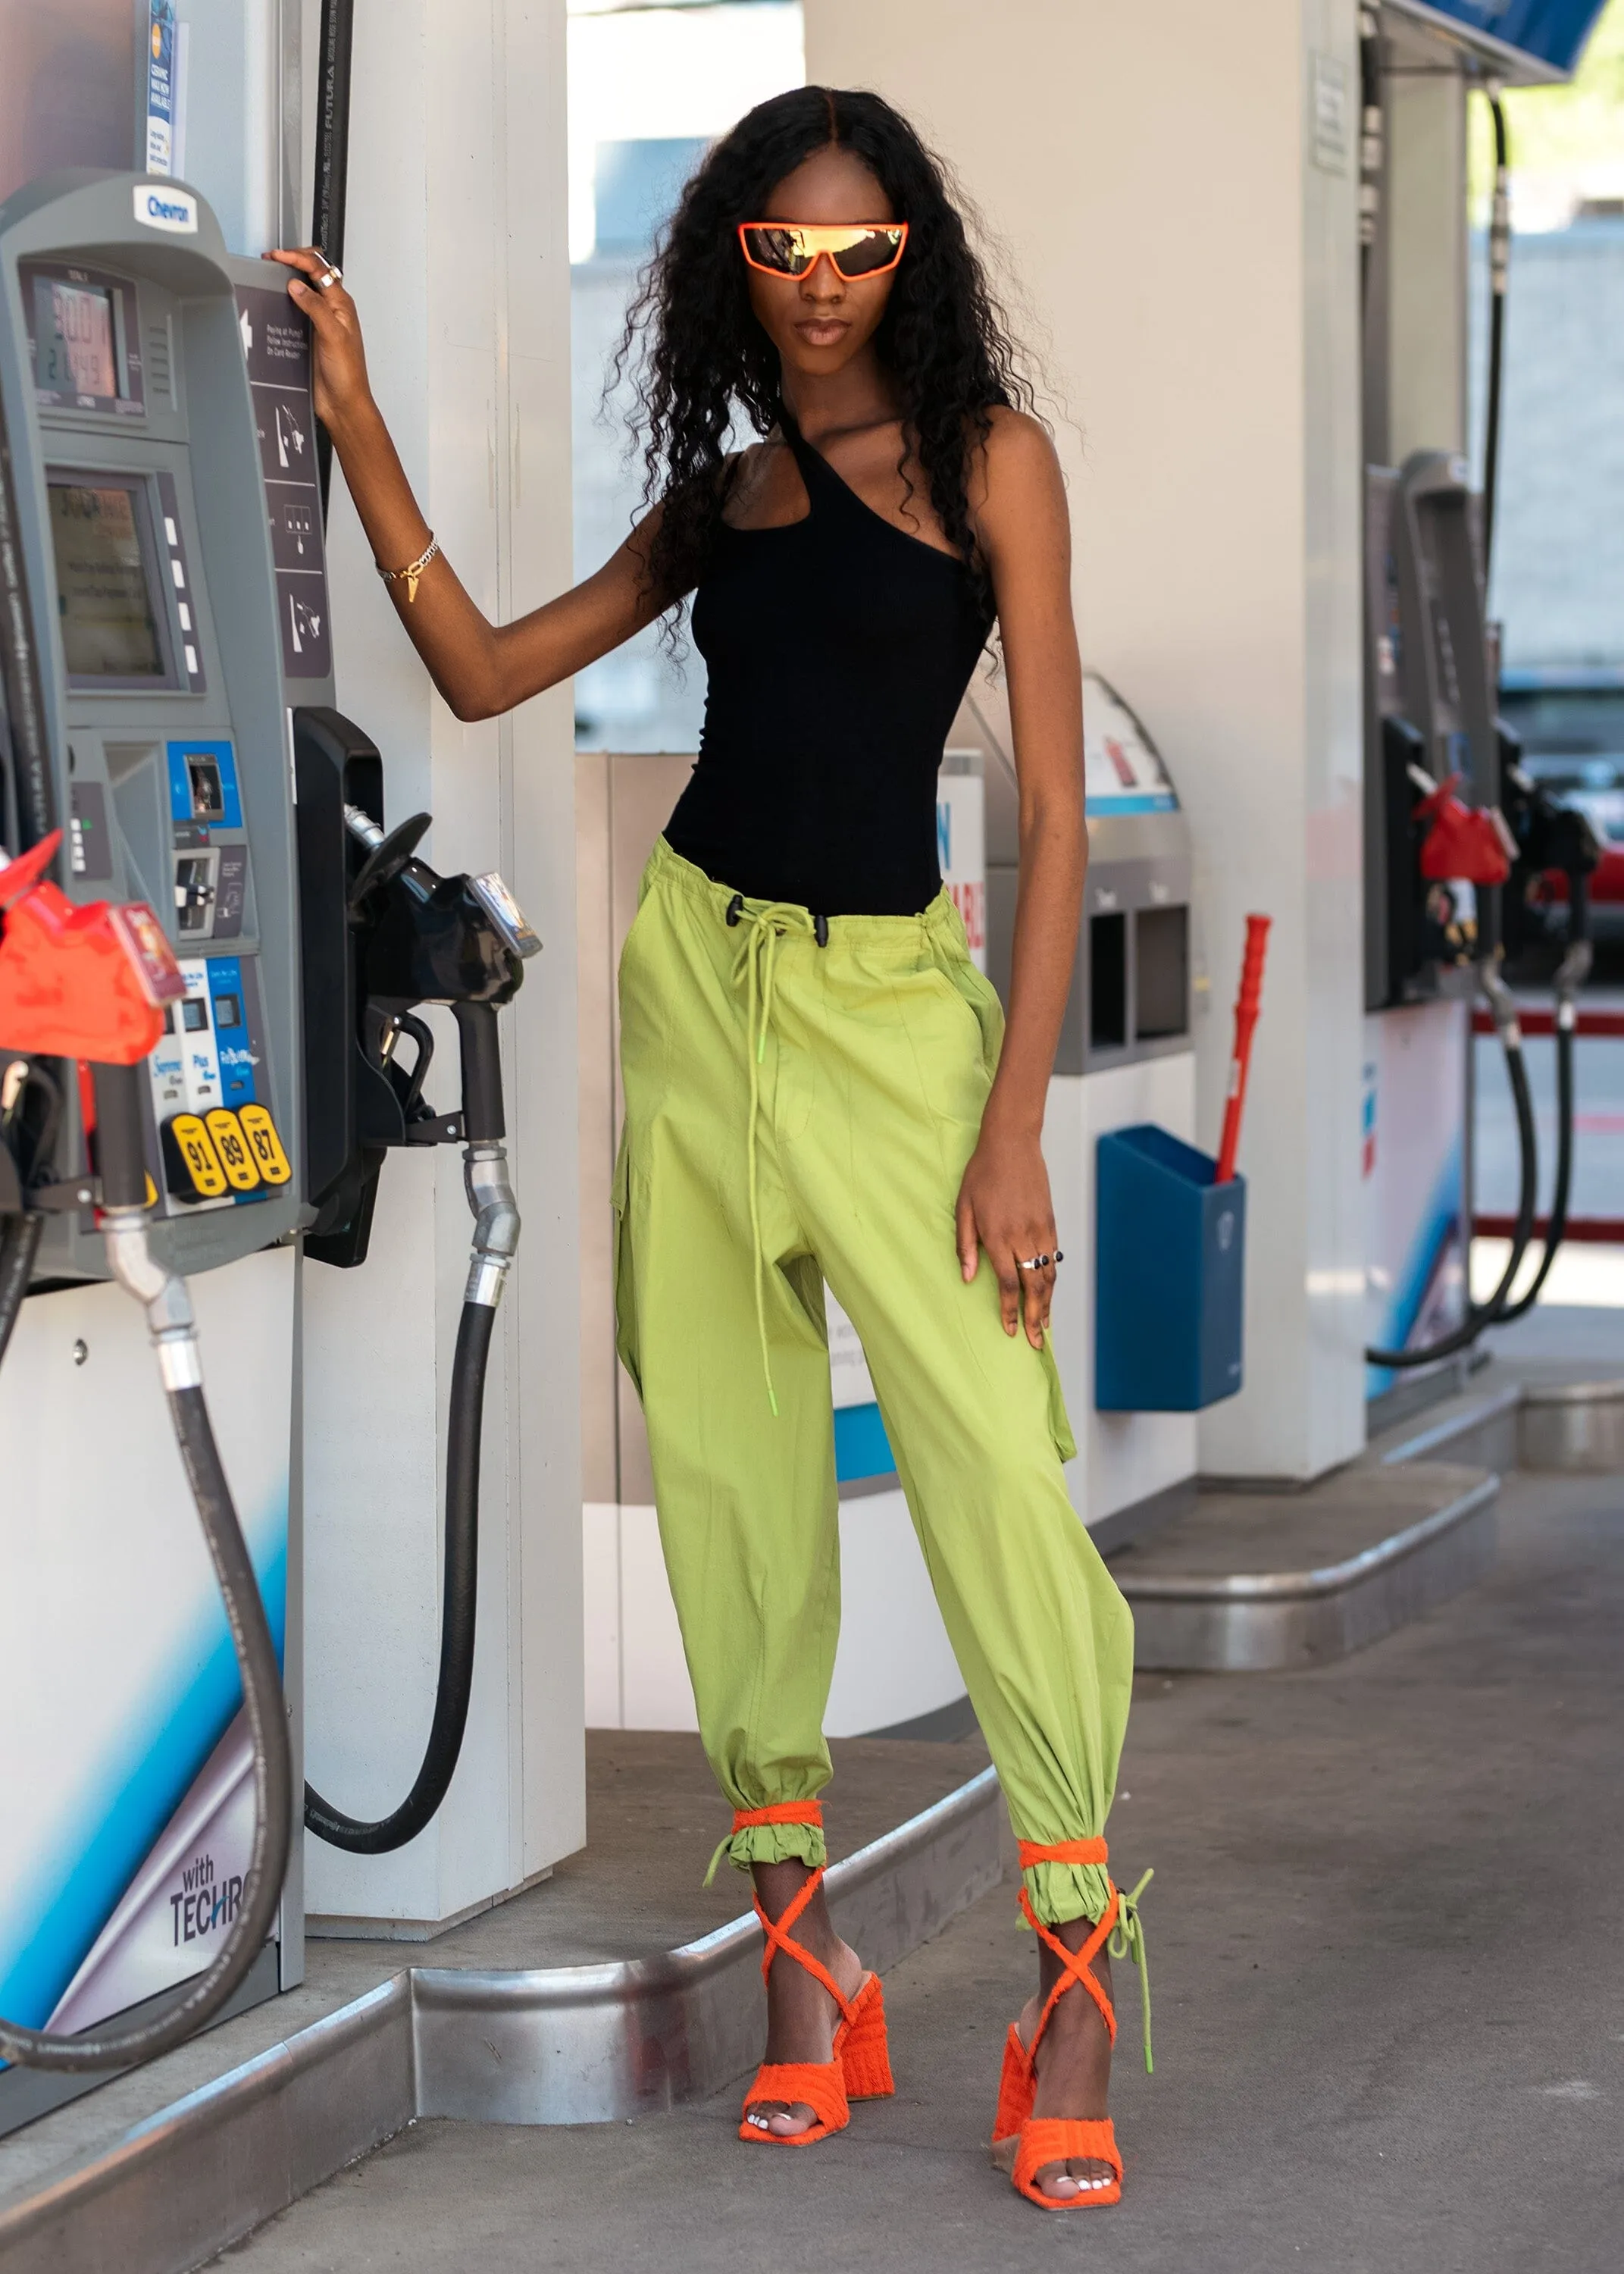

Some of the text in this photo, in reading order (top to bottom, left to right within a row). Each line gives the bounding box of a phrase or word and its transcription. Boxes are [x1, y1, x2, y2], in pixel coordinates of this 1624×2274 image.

[325, 66, 335, 129] FUTURA
[148, 194, 189, 223] Chevron
[267, 324, 282, 337] Paying
[267, 334, 280, 346] Follow
[192, 1054, 208, 1068] Plus
[187, 1139, 213, 1172] 91
[220, 1134, 245, 1166] 89
[252, 1129, 275, 1160] 87
[183, 1854, 214, 1893] with
